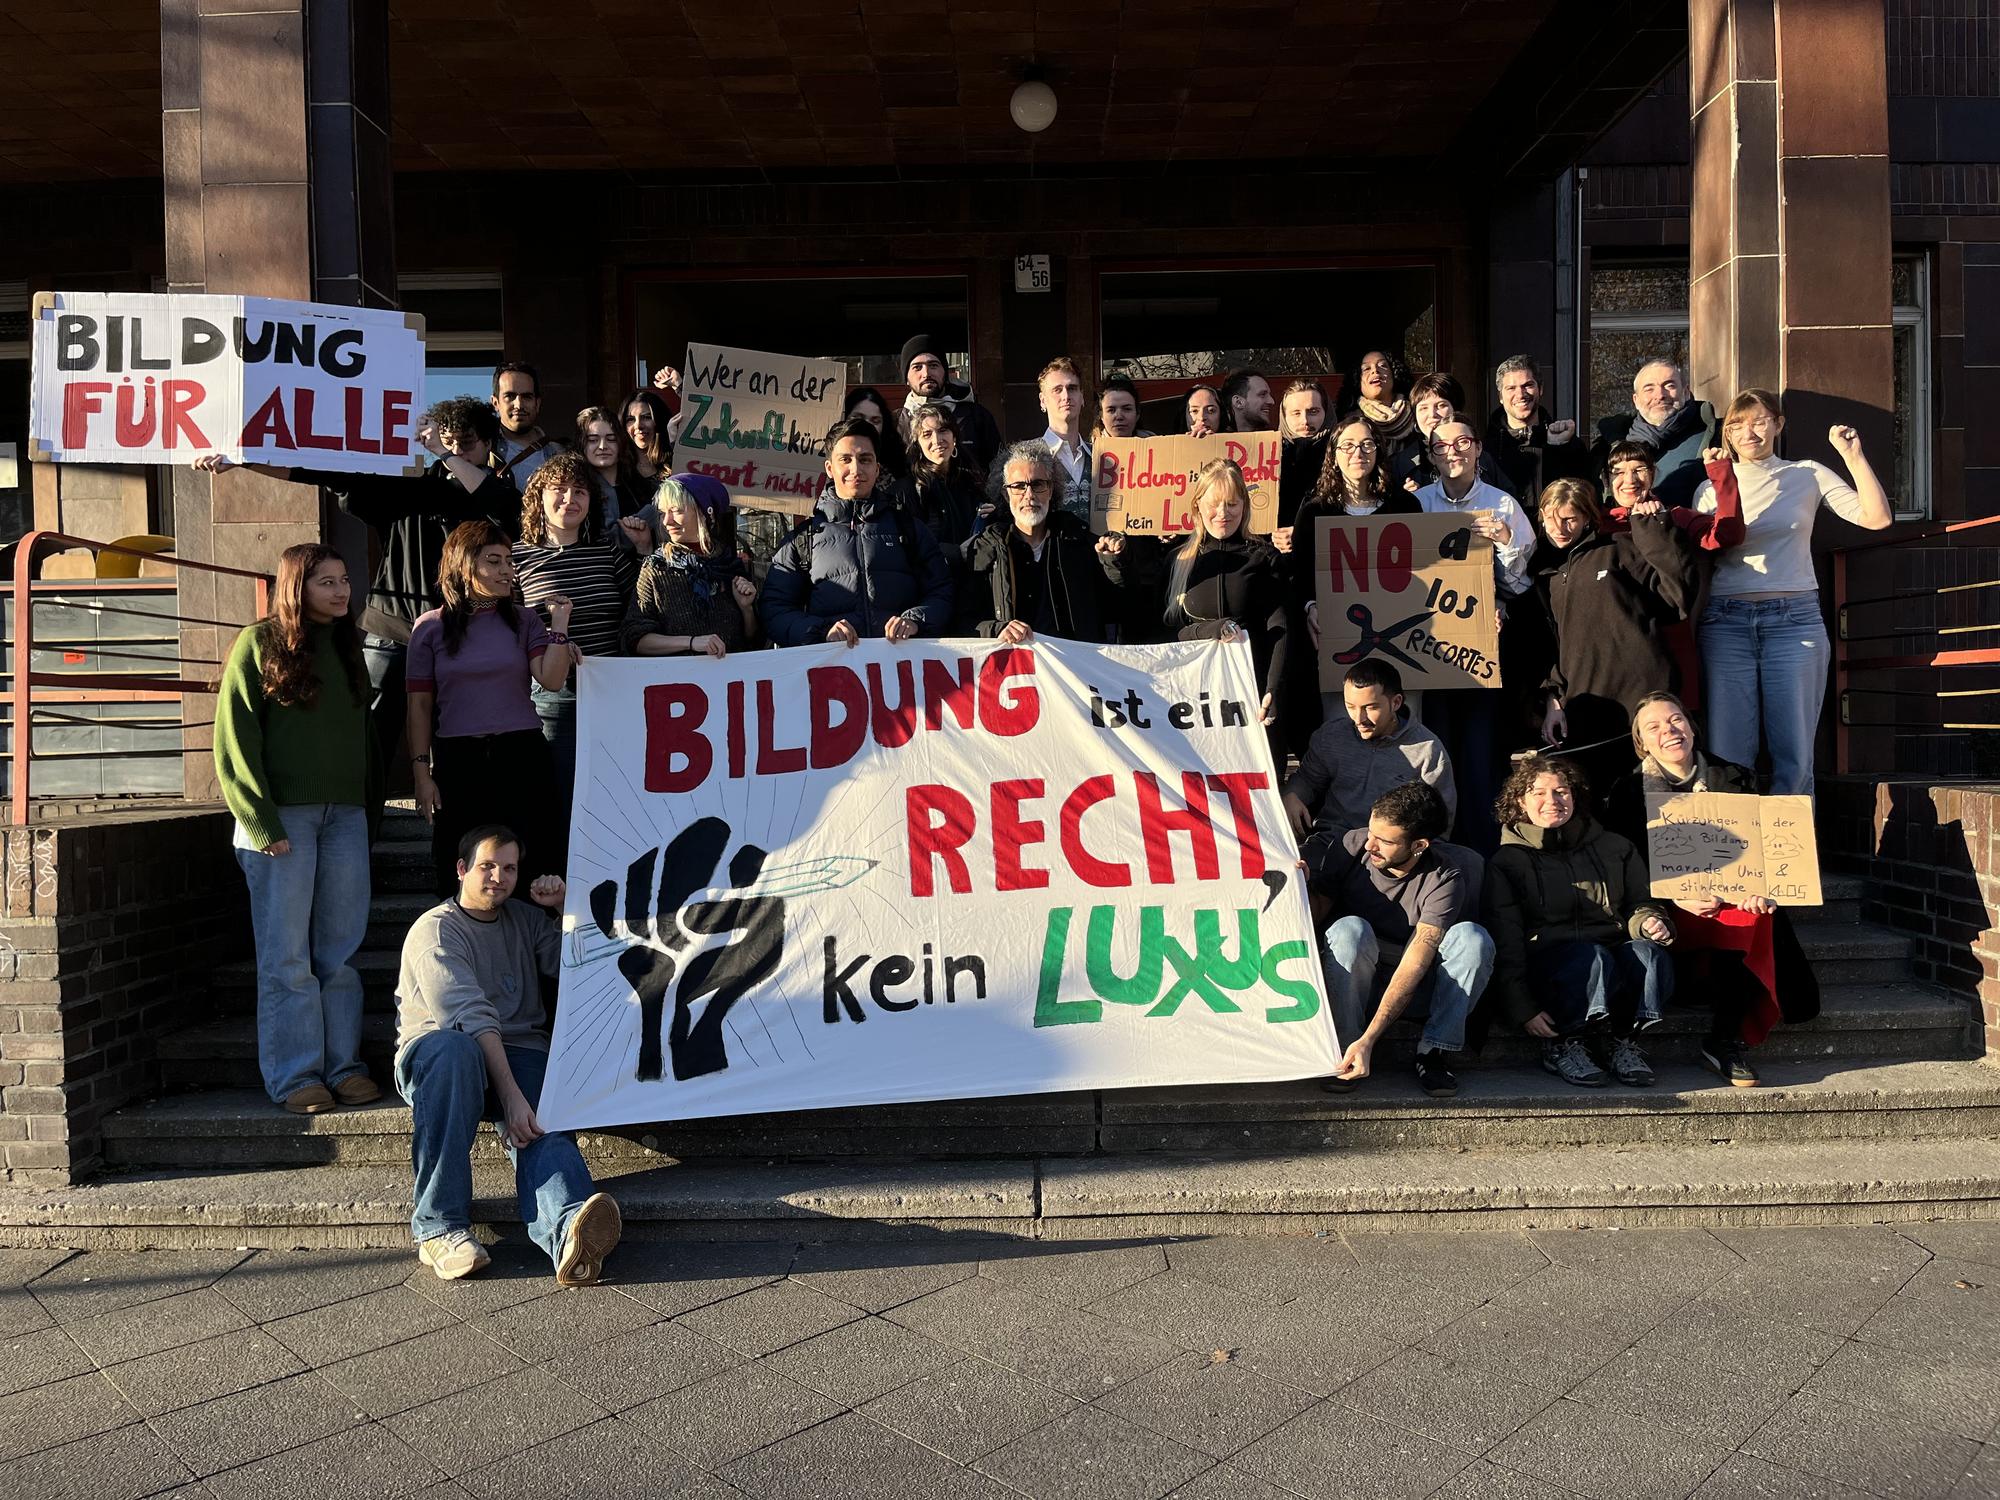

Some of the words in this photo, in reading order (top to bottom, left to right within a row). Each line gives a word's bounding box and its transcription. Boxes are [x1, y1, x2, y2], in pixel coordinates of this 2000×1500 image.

[1032, 271, 1048, 287] 56
[57, 314, 367, 378] BILDUNG
[688, 348, 743, 391] Wer
[749, 371, 779, 396] an
[790, 366, 836, 403] der
[62, 376, 212, 449] FÜR
[237, 387, 412, 455] ALLE
[679, 393, 788, 451] Zukunft
[1098, 448, 1186, 496] Bildung
[1125, 513, 1153, 530] kein
[1329, 522, 1412, 593] NO
[1438, 527, 1471, 561] a
[1425, 578, 1478, 619] los
[1405, 628, 1497, 680] RECORTES
[643, 648, 1041, 793] BILDUNG
[1088, 685, 1151, 729] ist
[1167, 692, 1249, 729] ein
[1662, 812, 1738, 832] Kürzungen
[1751, 818, 1761, 828] in
[1773, 817, 1796, 827] der
[1661, 863, 1721, 875] marode
[1738, 865, 1764, 878] Unis
[1775, 863, 1788, 877] &
[1680, 881, 1746, 893] stinkende
[821, 934, 988, 1024] kein
[1033, 904, 1321, 1028] LUXUS
